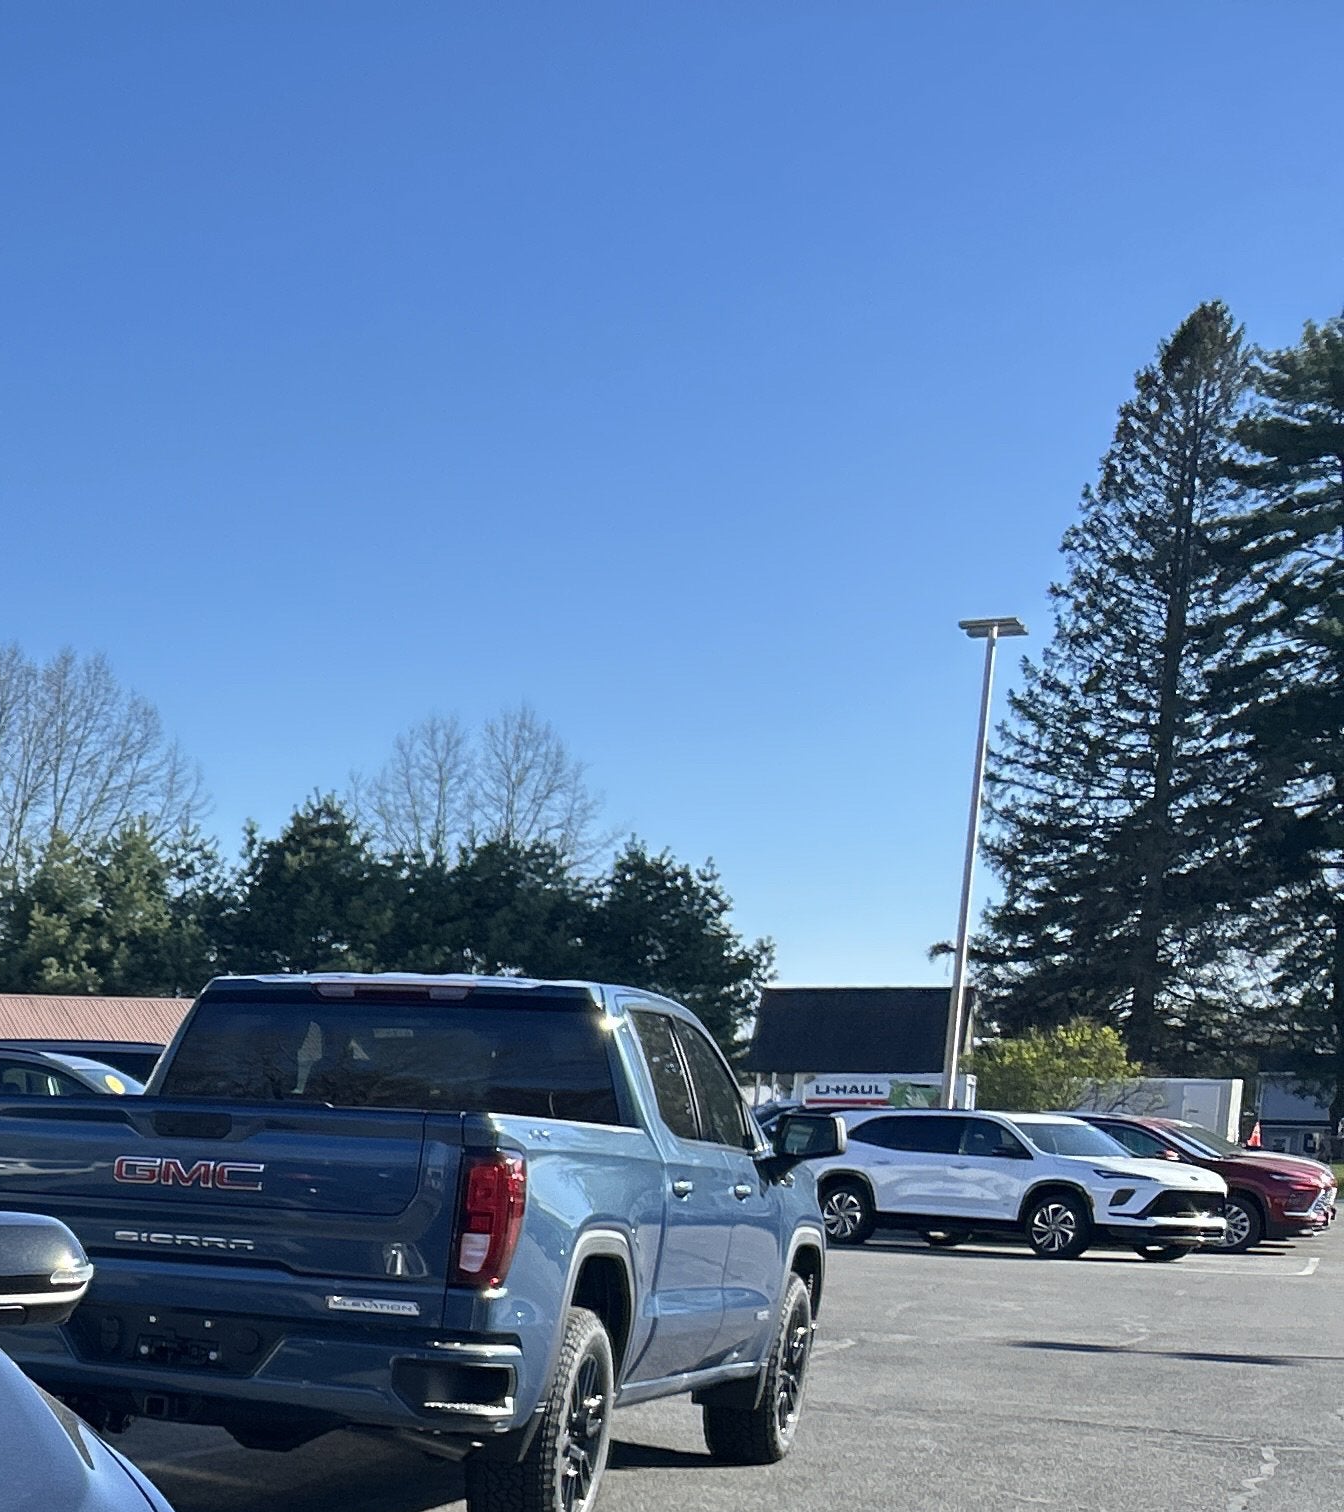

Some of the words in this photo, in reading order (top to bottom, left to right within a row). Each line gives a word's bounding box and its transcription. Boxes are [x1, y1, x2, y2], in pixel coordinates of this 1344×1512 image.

[815, 1084, 884, 1095] U-HAUL
[113, 1155, 264, 1191] GMC
[114, 1230, 255, 1250] SIERRA
